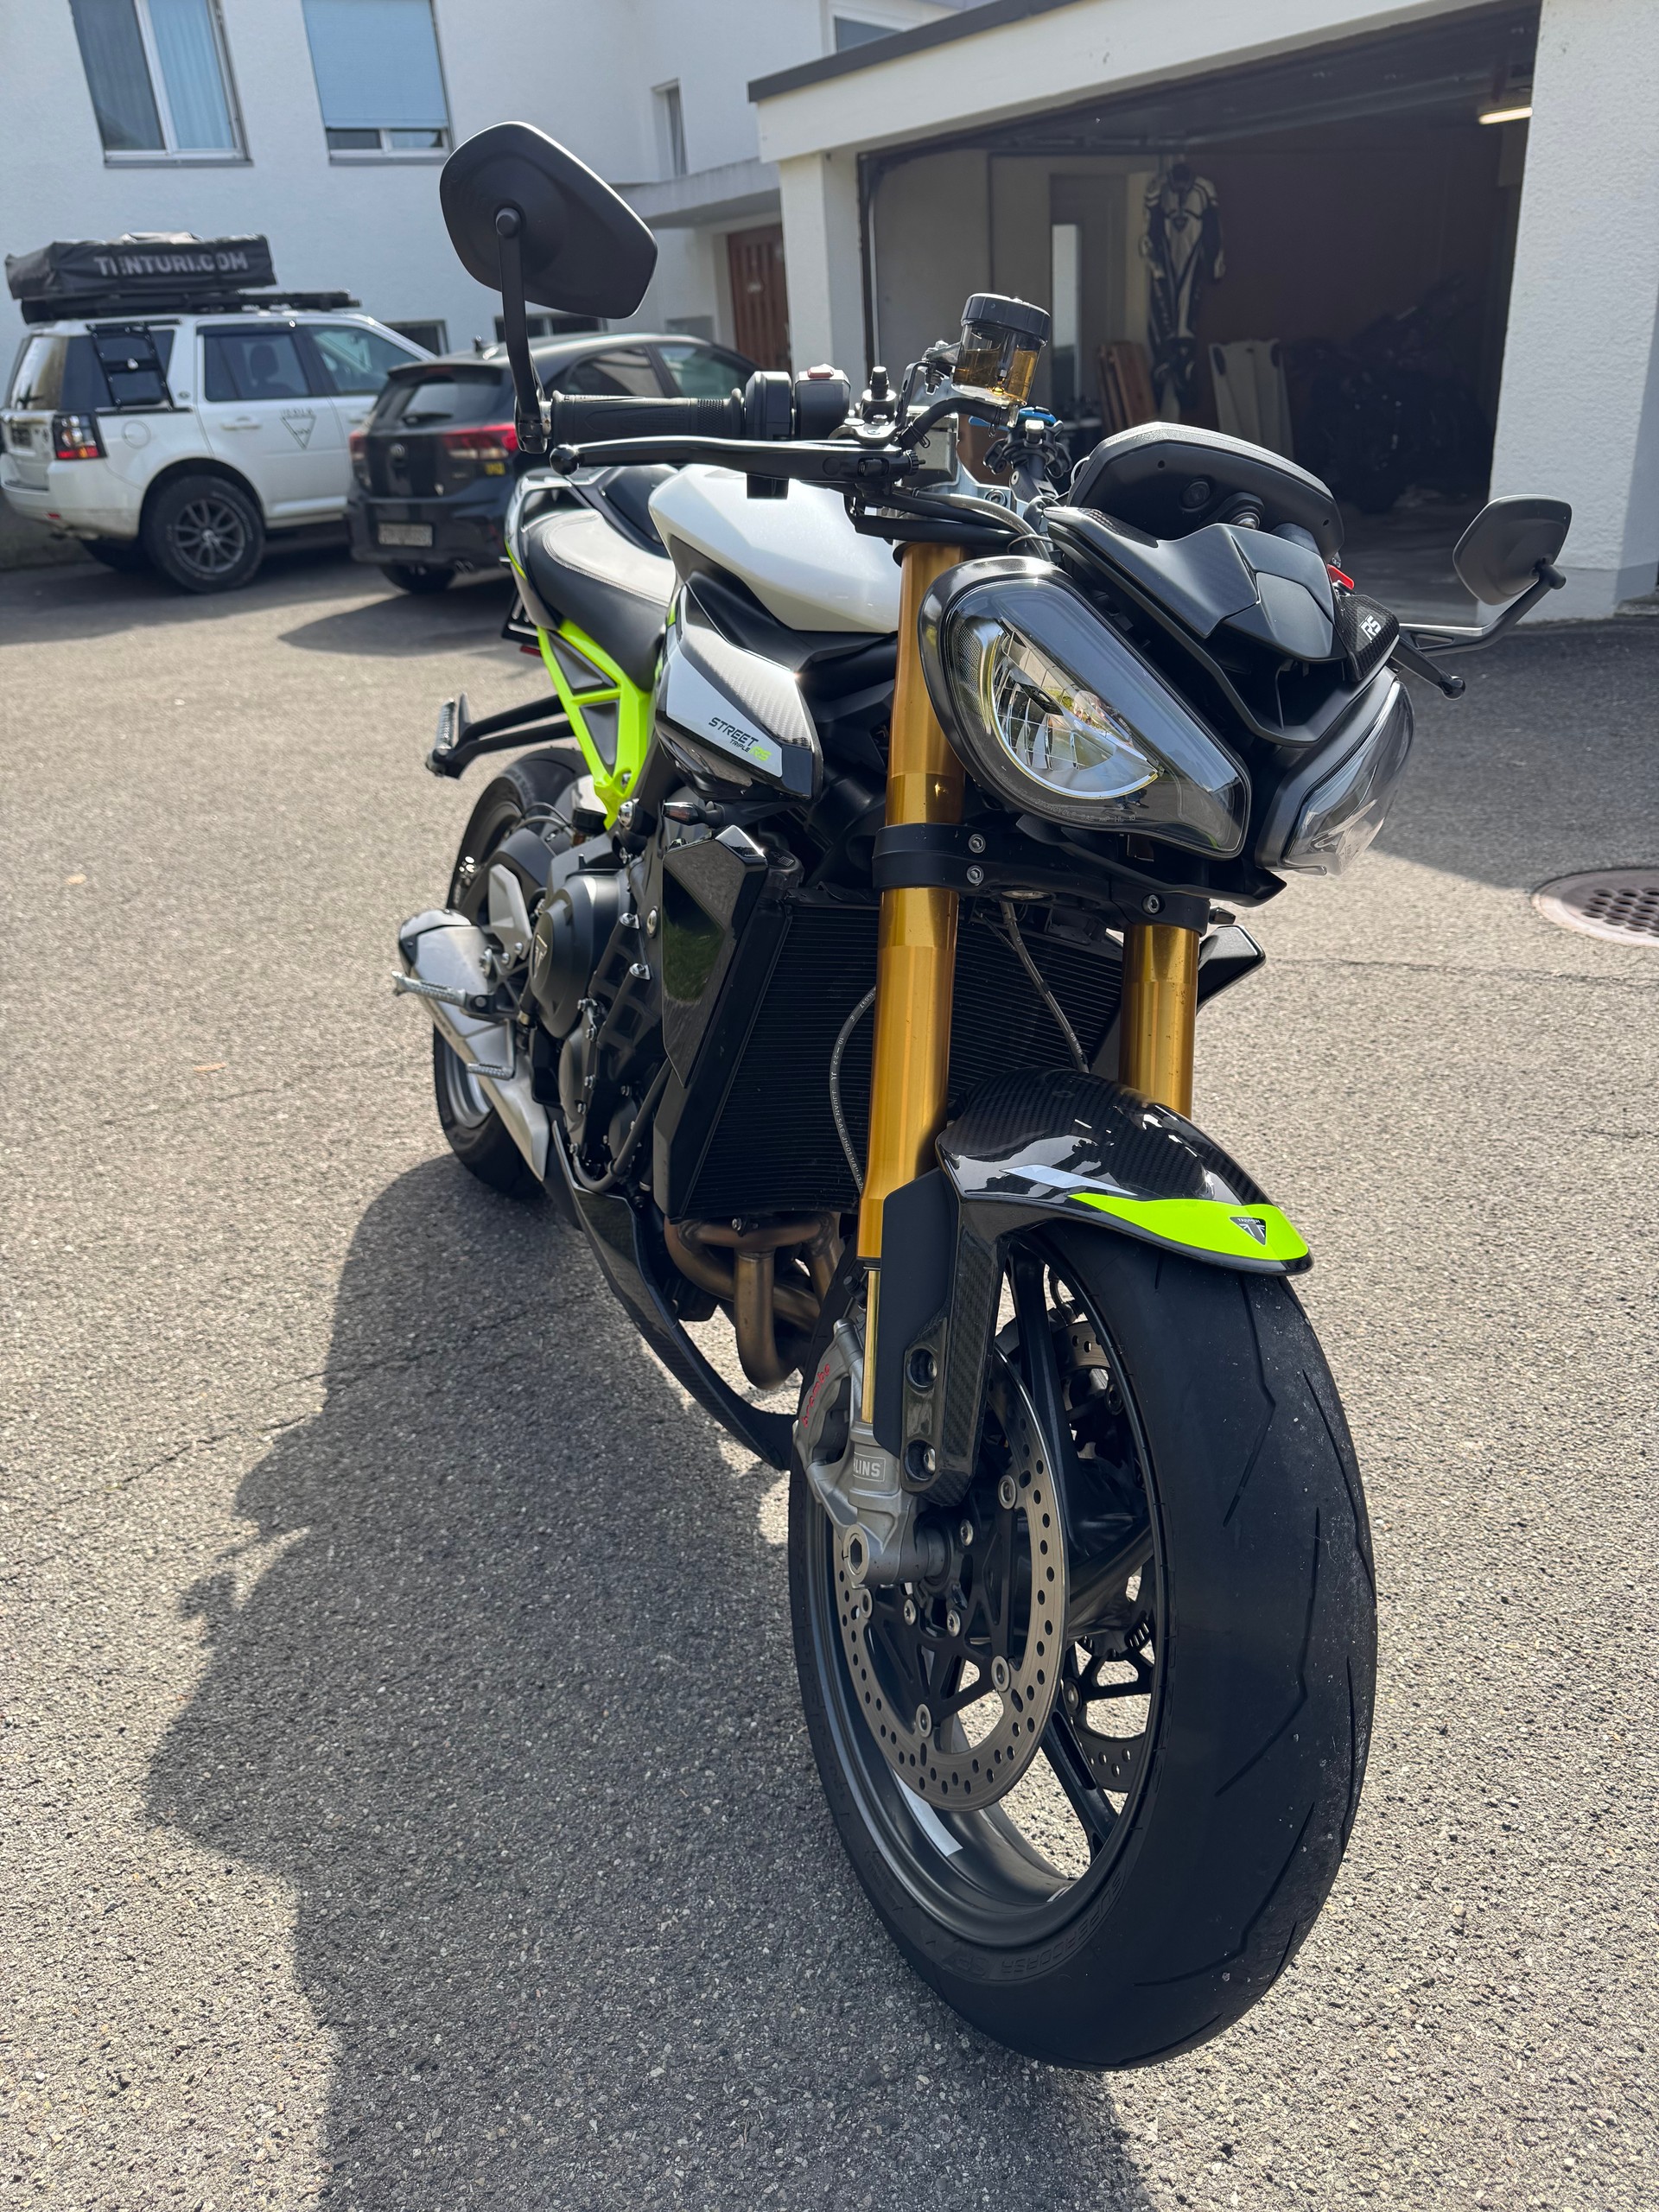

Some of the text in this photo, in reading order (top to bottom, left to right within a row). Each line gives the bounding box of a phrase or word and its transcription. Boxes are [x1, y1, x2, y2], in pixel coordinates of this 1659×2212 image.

[1359, 614, 1382, 641] RS
[708, 716, 760, 747] STREET
[729, 739, 772, 762] TRIPLE RS
[801, 1363, 830, 1428] brembo
